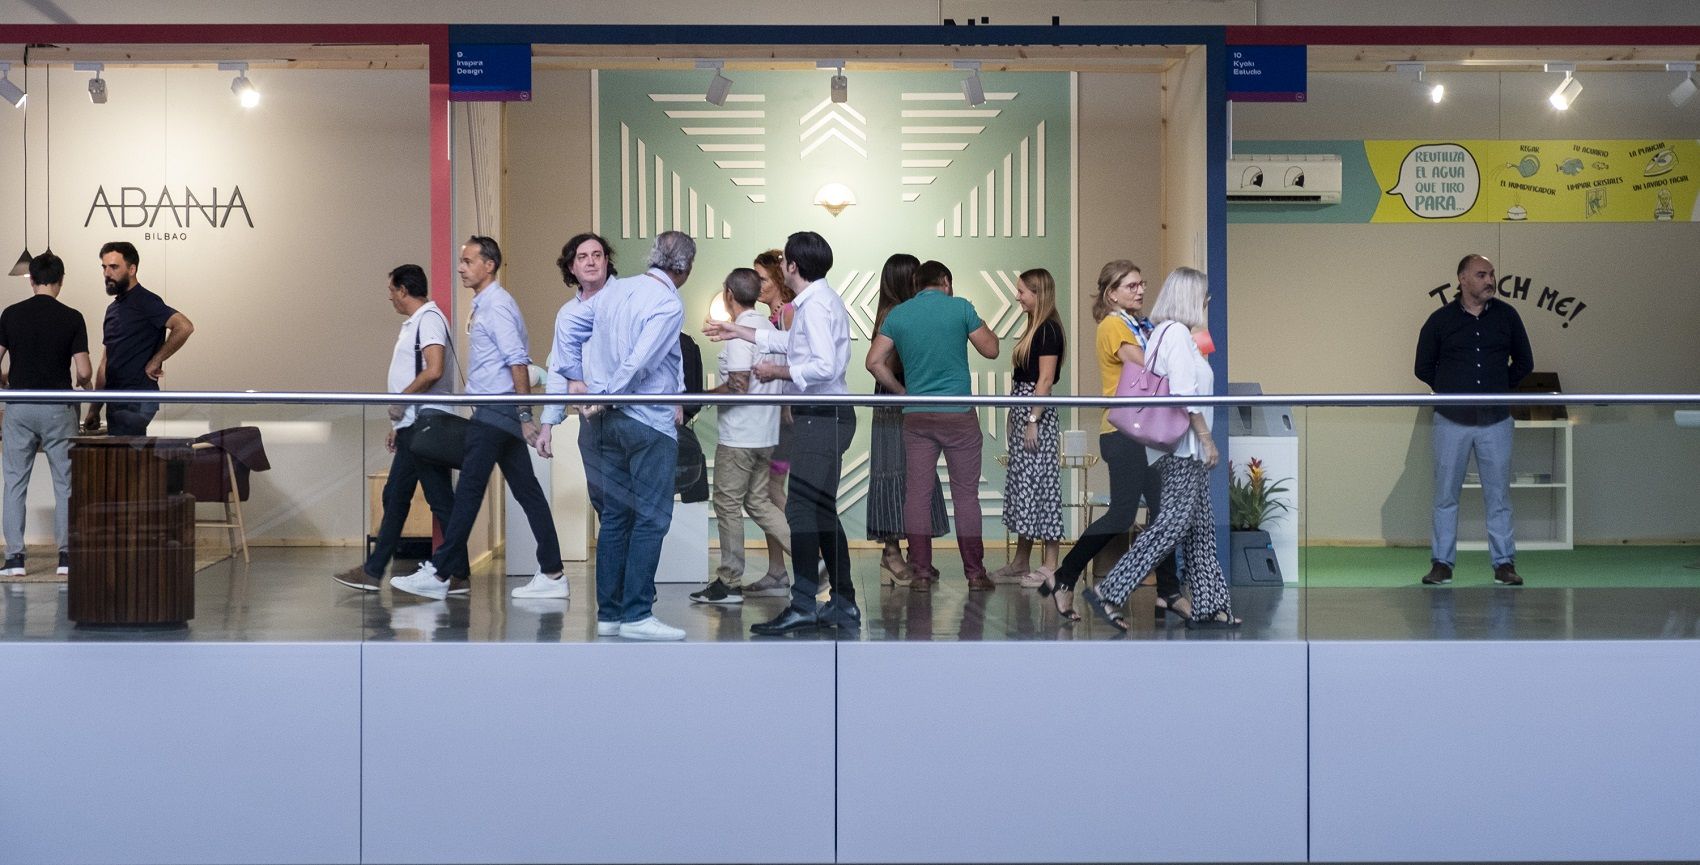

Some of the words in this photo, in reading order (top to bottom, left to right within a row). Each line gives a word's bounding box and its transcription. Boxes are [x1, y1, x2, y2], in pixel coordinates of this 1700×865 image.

[1519, 145, 1540, 153] REGAR
[1581, 147, 1609, 157] ACUARIO
[1628, 150, 1638, 158] LA
[1638, 142, 1666, 153] PLANCHA
[1415, 151, 1465, 162] REUTILIZA
[1416, 166, 1426, 178] EL
[1432, 166, 1465, 178] AGUA
[1415, 182, 1437, 193] QUE
[1441, 182, 1465, 193] TIRO
[1508, 181, 1556, 196] HUMIDIFICADOR
[1567, 182, 1591, 191] LIMPIAR
[1593, 177, 1624, 188] CRISTALES
[1643, 180, 1668, 189] LAVADO
[1669, 175, 1689, 183] FACIAL
[84, 184, 254, 228] ABANA
[1415, 195, 1465, 211] PARA...
[144, 232, 187, 241] BILBAO
[1428, 275, 1532, 307] TCH
[1537, 286, 1587, 329] ME!
